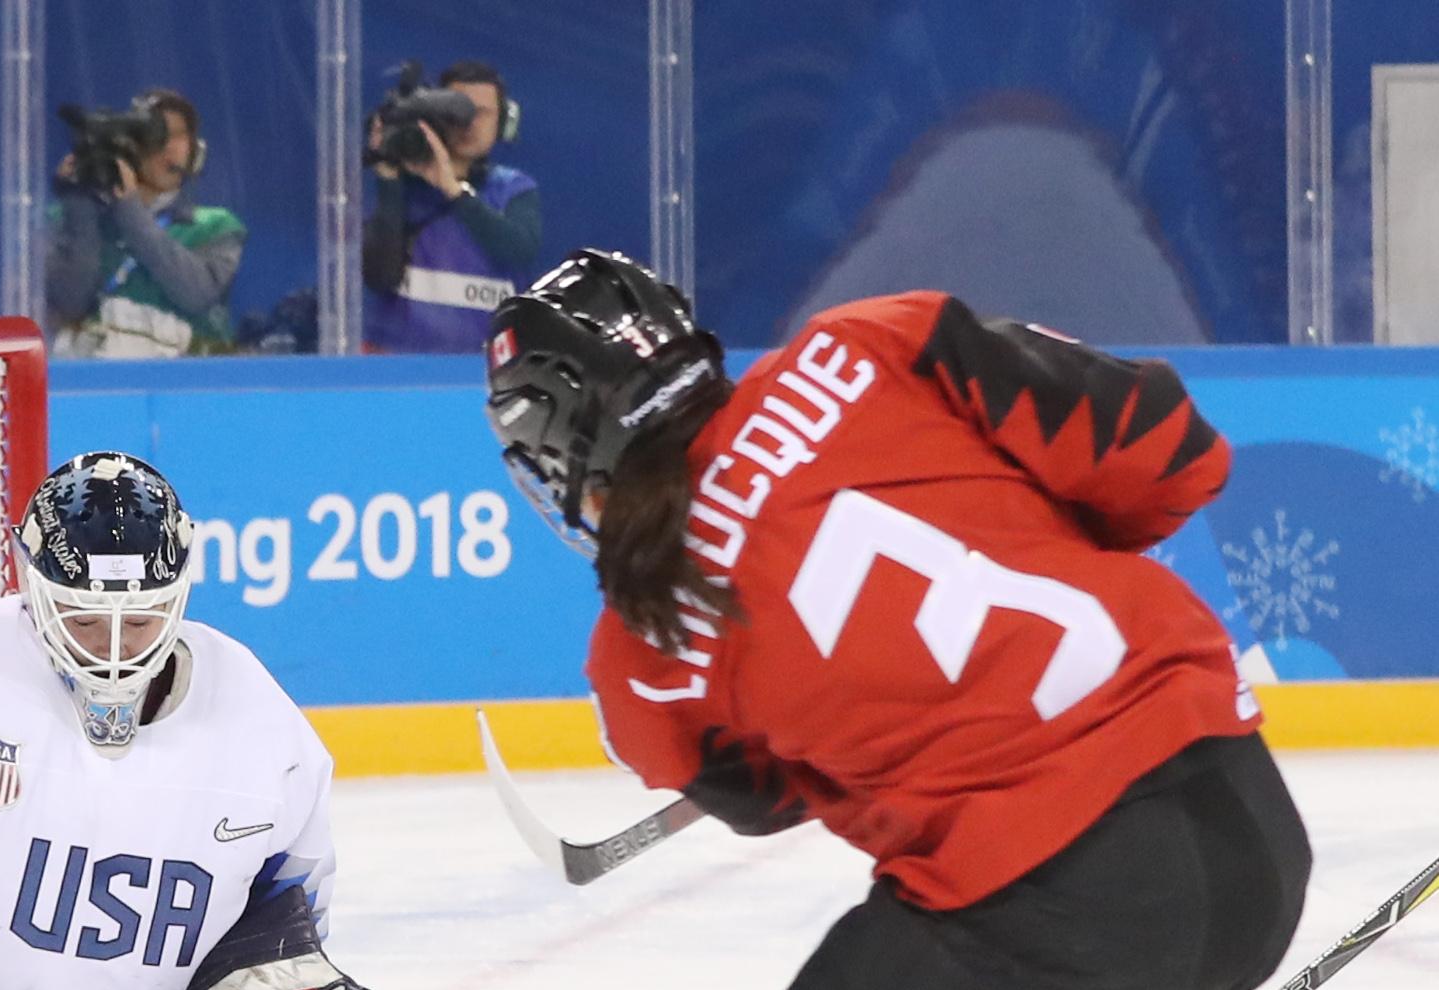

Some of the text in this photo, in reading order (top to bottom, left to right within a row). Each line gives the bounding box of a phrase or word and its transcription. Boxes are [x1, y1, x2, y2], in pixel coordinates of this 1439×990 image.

[307, 490, 512, 581] 2018
[789, 487, 1128, 722] 3
[10, 837, 215, 968] USA
